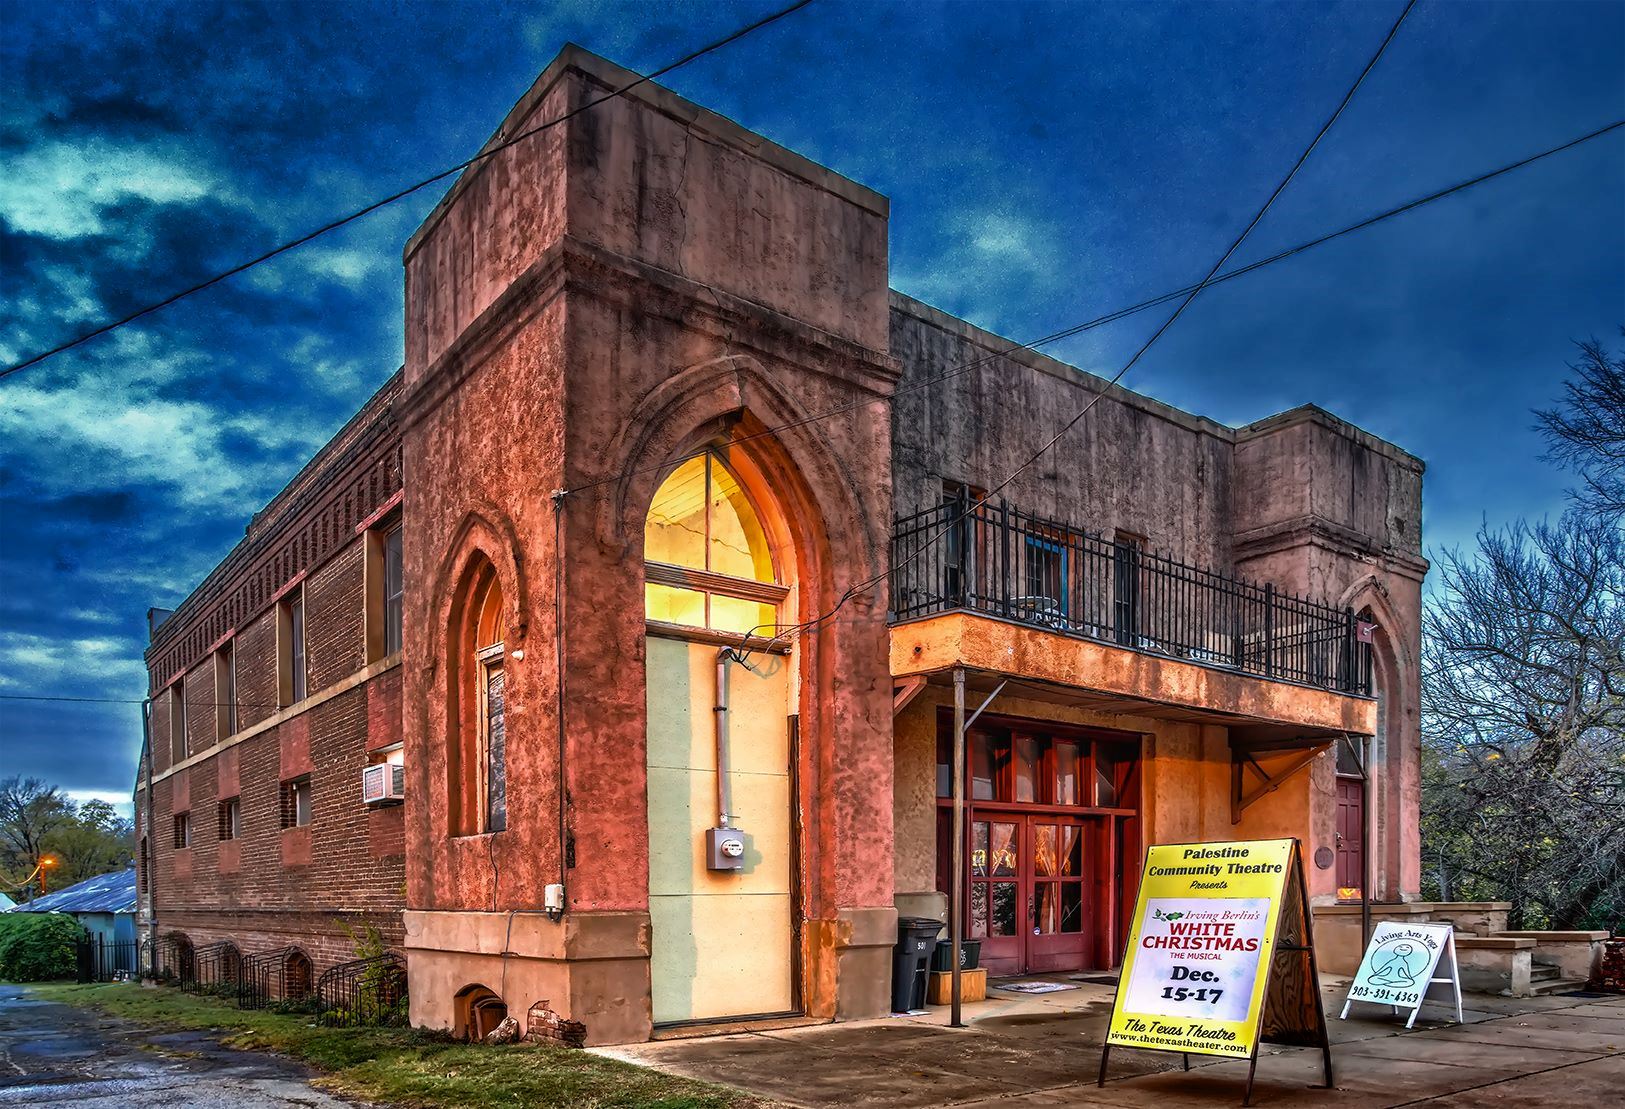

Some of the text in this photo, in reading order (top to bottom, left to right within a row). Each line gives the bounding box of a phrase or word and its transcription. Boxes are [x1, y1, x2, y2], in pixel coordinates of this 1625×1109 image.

[1183, 847, 1249, 859] Palestine
[1148, 863, 1282, 876] Community Theatre
[1189, 880, 1228, 889] Presents
[1185, 910, 1260, 923] Irving Berlin's
[1169, 923, 1235, 936] WHITE
[1142, 936, 1258, 952] CHRISTMAS
[1375, 930, 1438, 949] Living Arts Yoga
[1170, 965, 1220, 983] Dec.
[1160, 986, 1224, 1004] 15-17
[1352, 986, 1418, 1003] 903-391-6369
[1124, 1019, 1236, 1041] The Texas Theatre
[1111, 1031, 1247, 1053] www.thetexastheater.com
